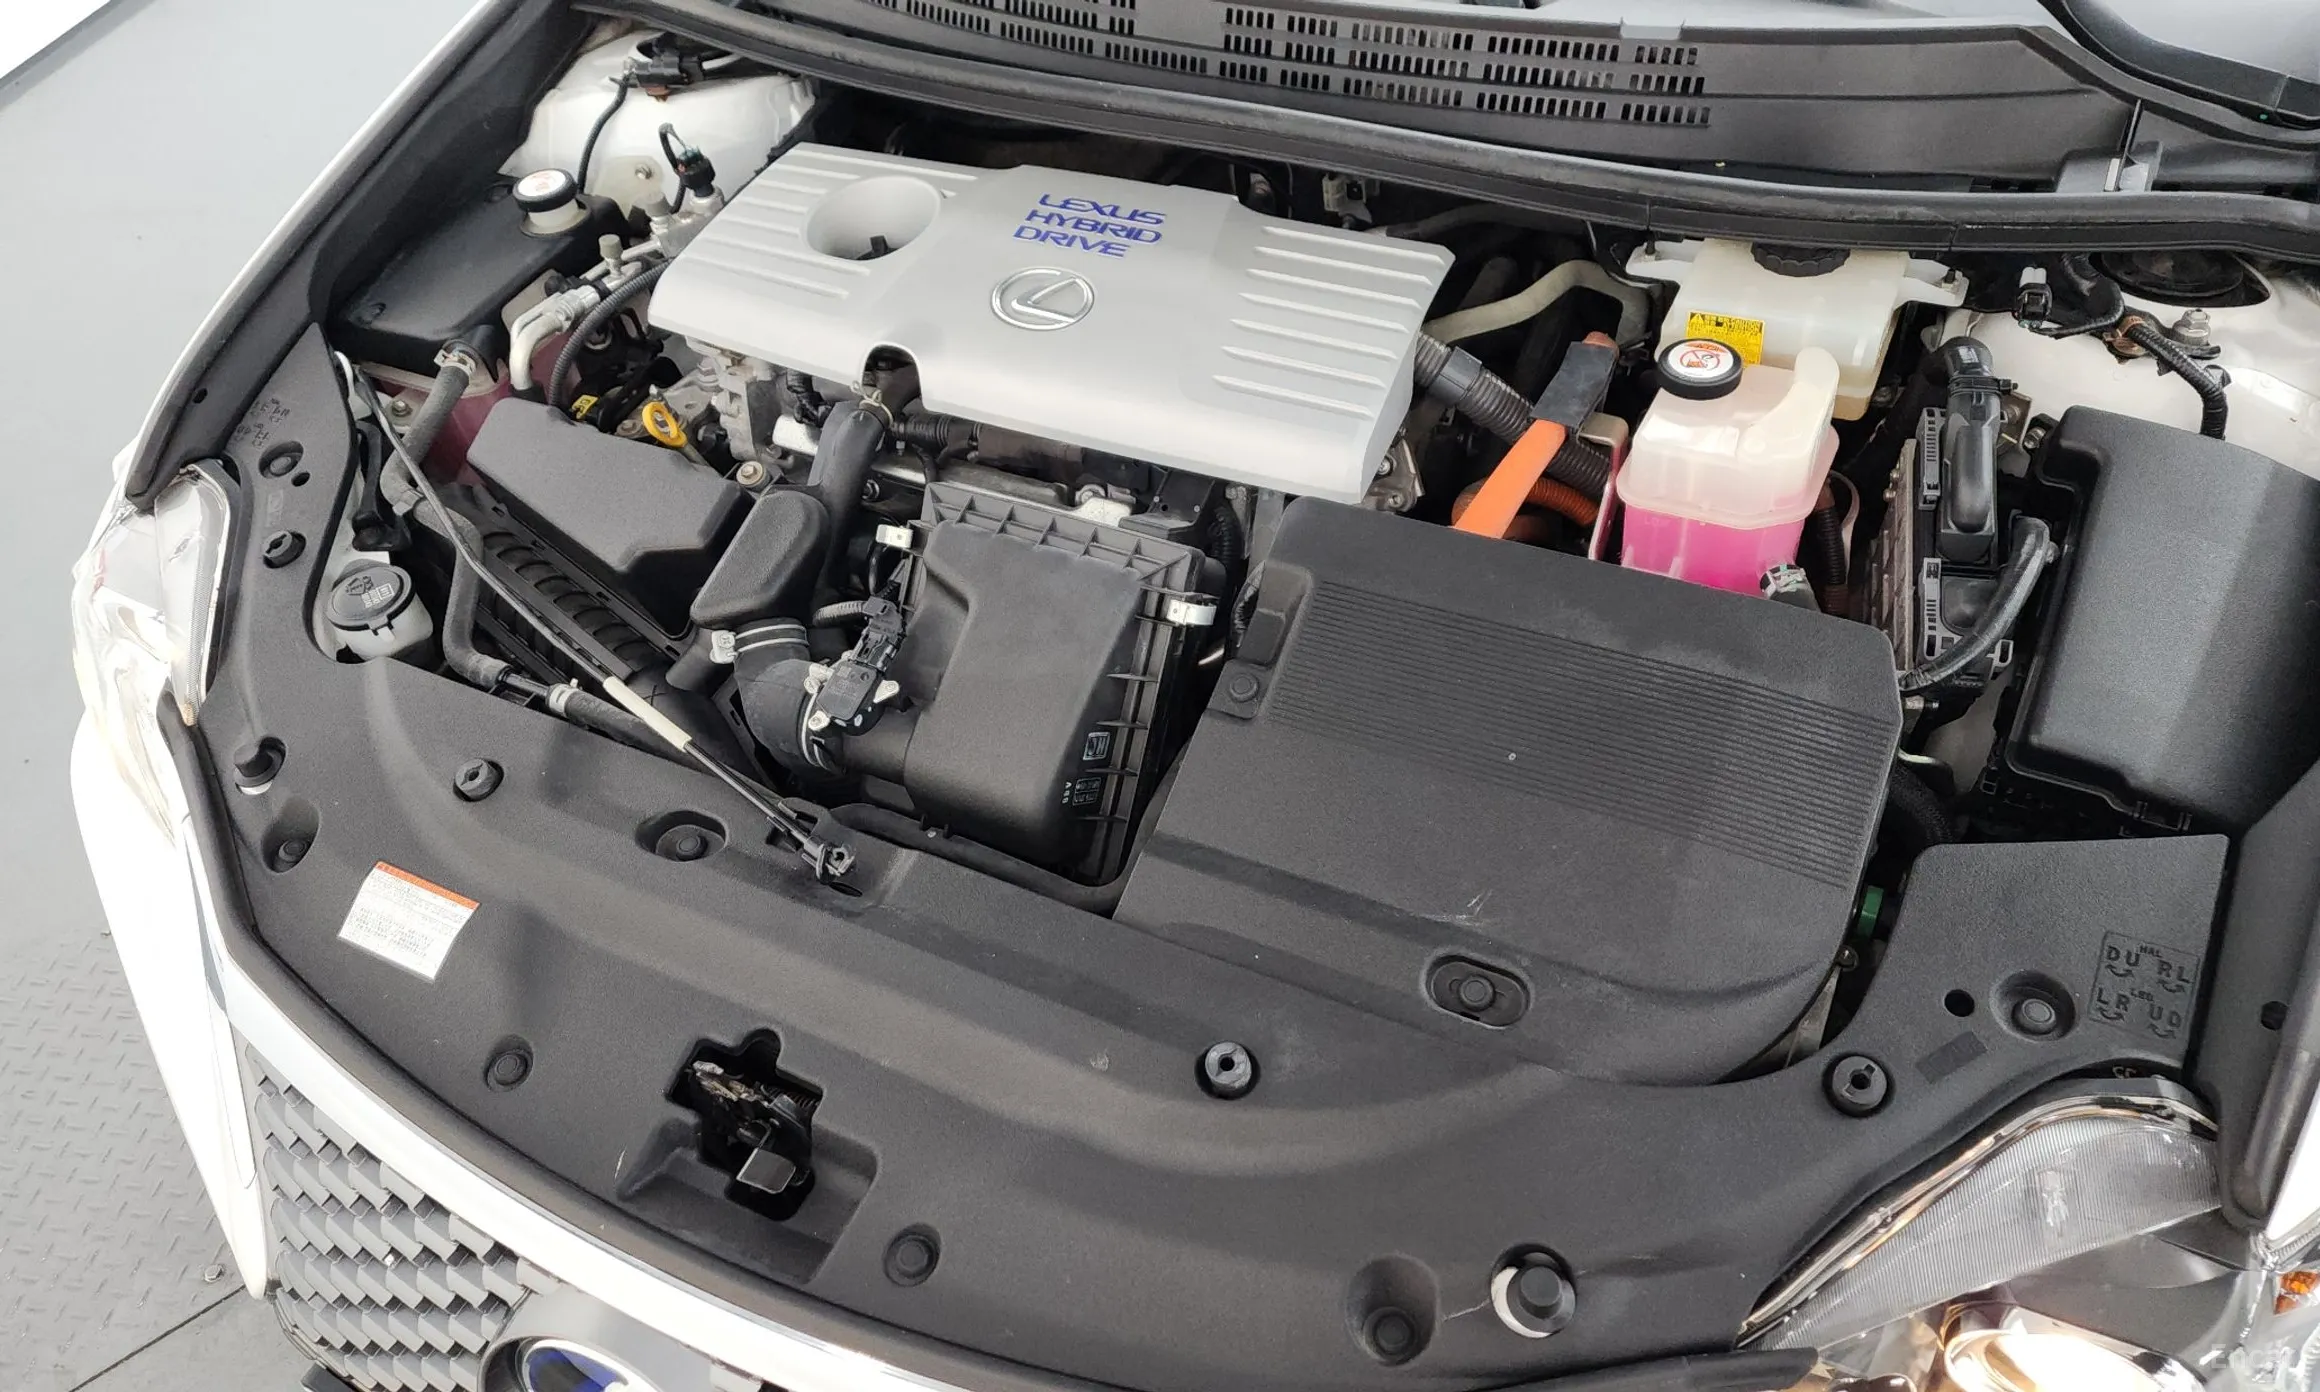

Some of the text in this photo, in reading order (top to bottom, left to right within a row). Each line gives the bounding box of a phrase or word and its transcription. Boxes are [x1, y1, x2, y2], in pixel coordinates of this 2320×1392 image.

[1025, 209, 1163, 243] HYBRID
[1039, 194, 1167, 225] LEXUS
[1013, 225, 1132, 258] DRIVE
